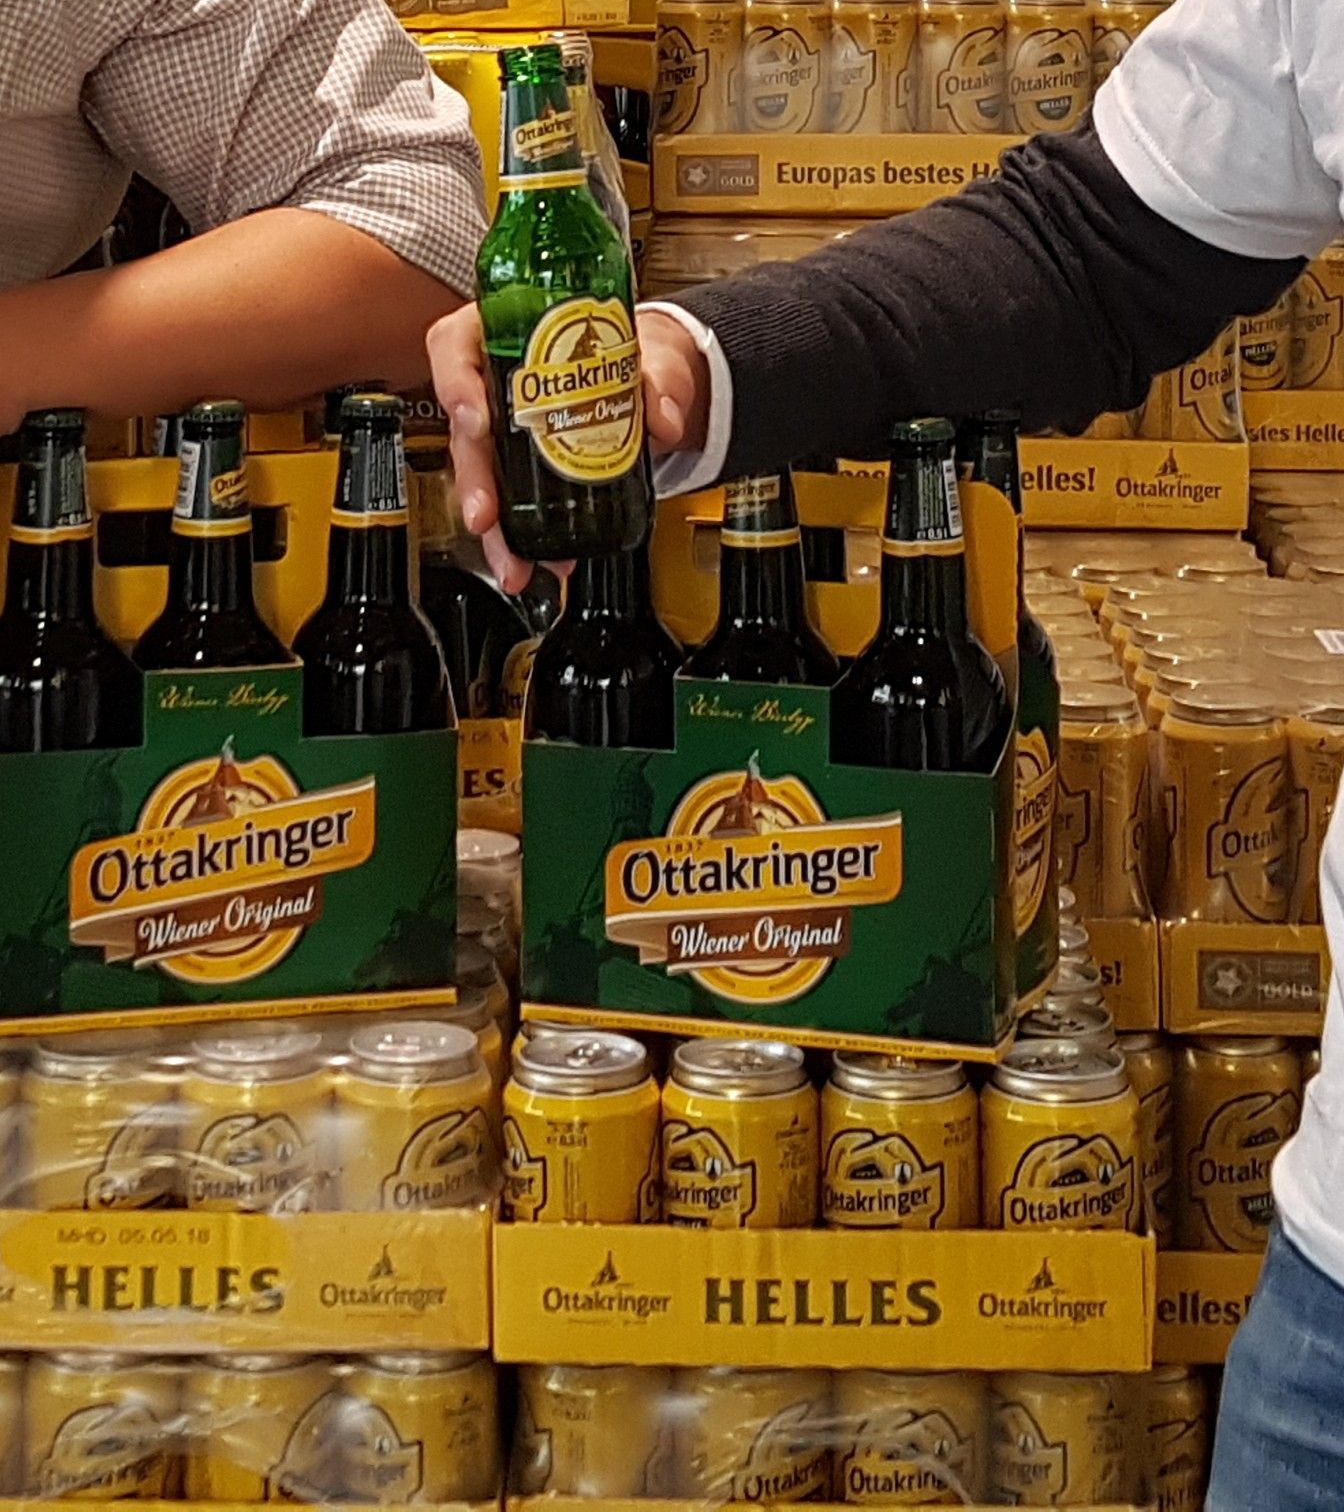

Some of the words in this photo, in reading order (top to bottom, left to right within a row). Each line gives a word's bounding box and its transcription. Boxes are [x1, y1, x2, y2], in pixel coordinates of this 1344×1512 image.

[777, 161, 875, 189] Europas
[883, 161, 964, 185] bestes
[406, 401, 447, 420] GOL
[1021, 465, 1096, 494] elles!
[1115, 477, 1222, 503] Ottakringer
[90, 809, 353, 904] Ottakringer
[623, 841, 880, 905] Ottakringer
[139, 913, 219, 951] Wiener
[225, 888, 314, 931] Original
[671, 922, 749, 958] Wiener
[755, 916, 843, 956] Original
[1010, 1182, 1128, 1225] Ottakringer
[52, 1262, 285, 1315] HELLES
[320, 1282, 447, 1310] Ottakringer
[542, 1286, 672, 1317] Ottakringer
[704, 1277, 943, 1327] HELLES
[978, 1292, 1108, 1322] Ottakringer
